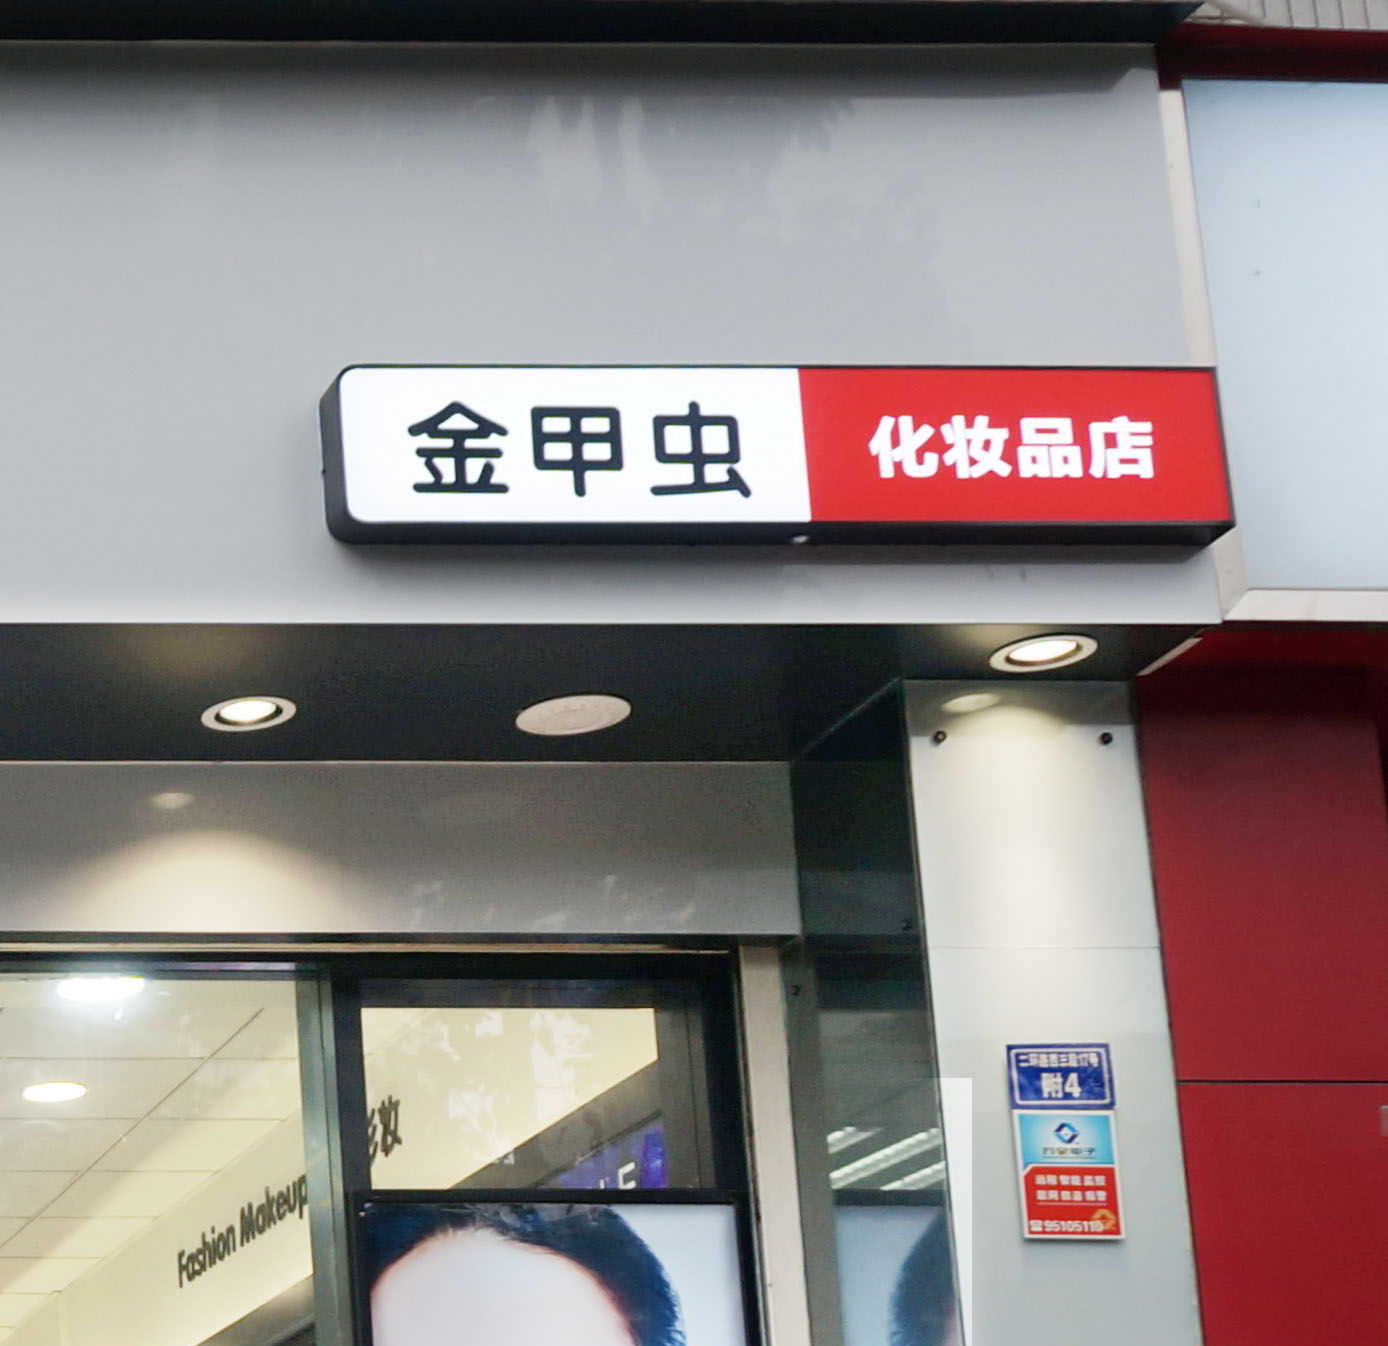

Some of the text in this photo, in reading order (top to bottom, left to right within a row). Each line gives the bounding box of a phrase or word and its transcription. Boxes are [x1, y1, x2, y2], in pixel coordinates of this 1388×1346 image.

[407, 400, 752, 499] 金甲虫
[868, 414, 1156, 481] 化妆品店
[177, 1173, 308, 1289] Fashion Makeup
